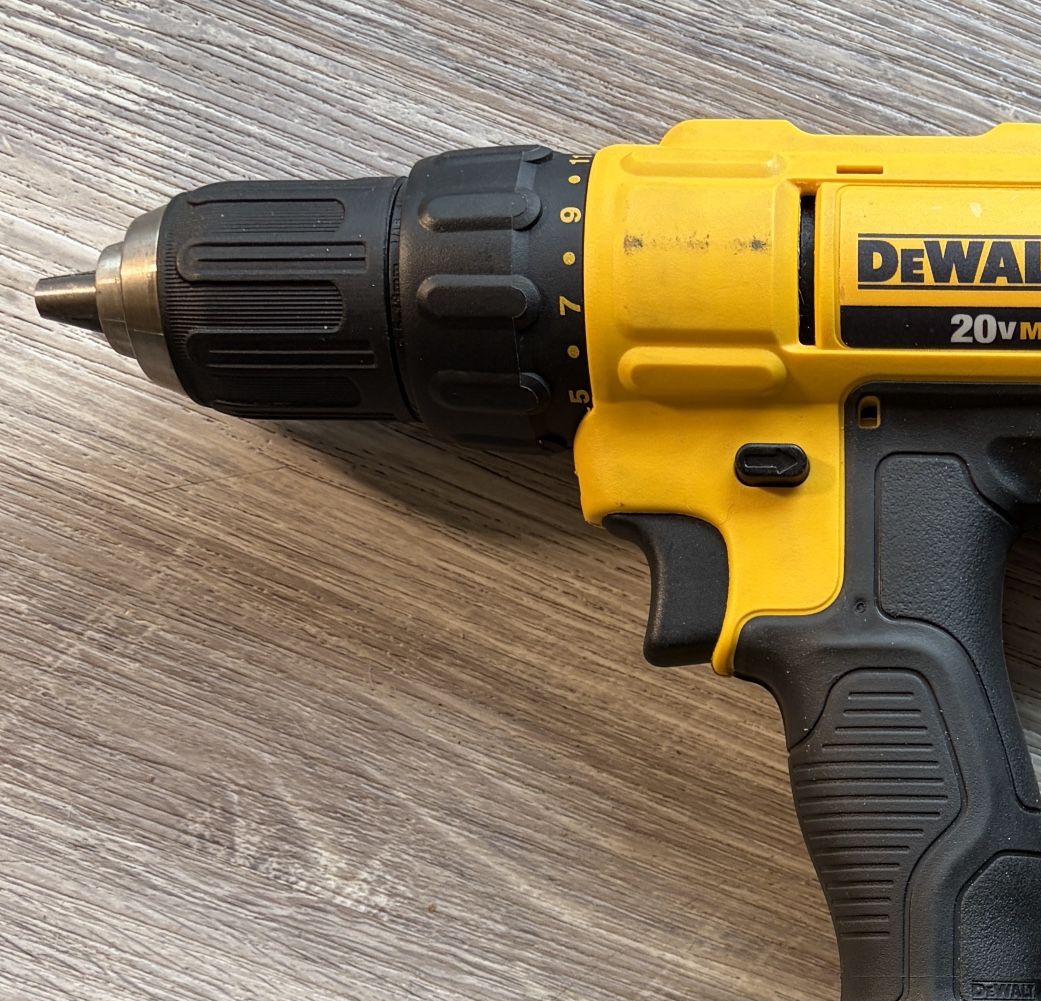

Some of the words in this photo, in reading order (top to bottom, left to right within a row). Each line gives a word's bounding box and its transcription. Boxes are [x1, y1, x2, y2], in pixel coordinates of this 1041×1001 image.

[569, 154, 592, 164] 11
[560, 207, 582, 224] 9
[559, 295, 582, 316] 7
[569, 389, 591, 404] 5
